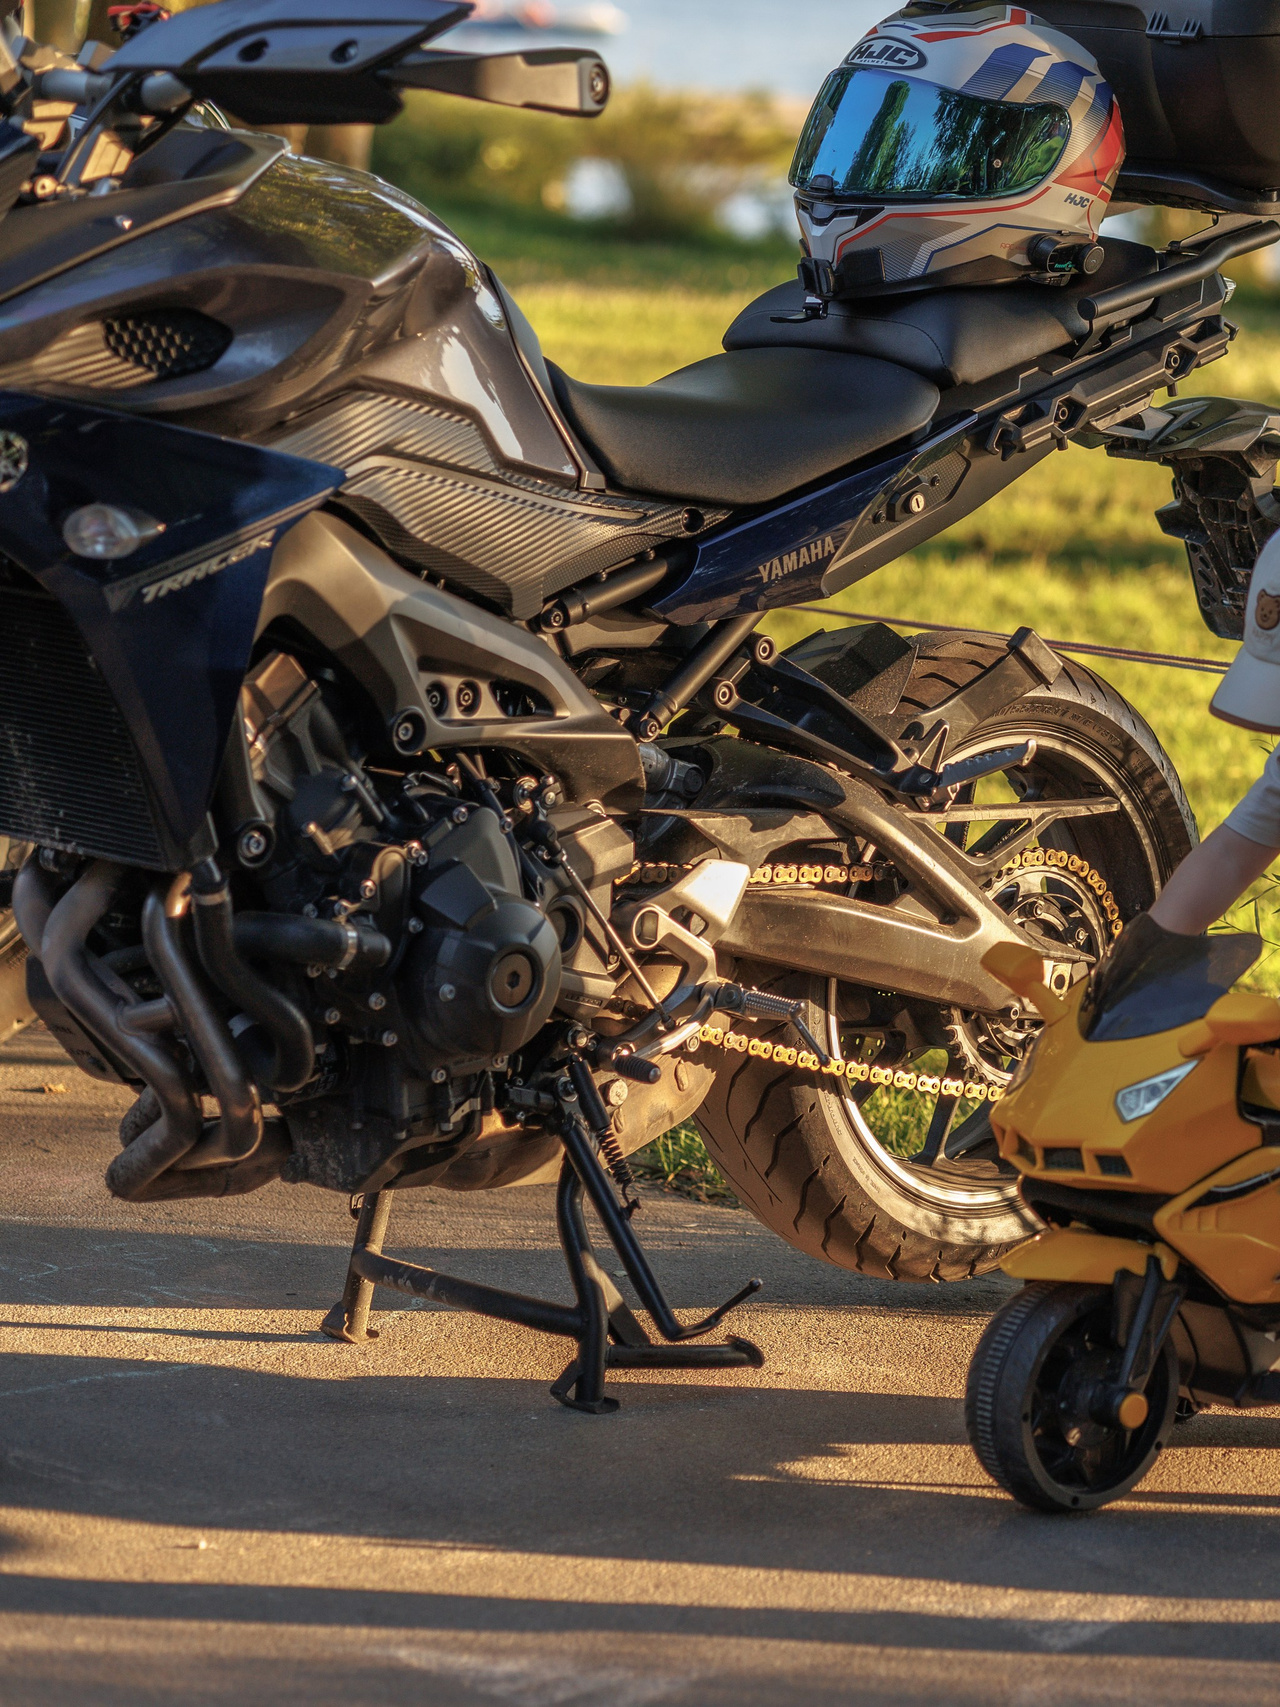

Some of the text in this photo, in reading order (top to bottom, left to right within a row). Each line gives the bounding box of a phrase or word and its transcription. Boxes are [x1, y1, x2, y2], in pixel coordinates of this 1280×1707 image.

[849, 44, 917, 65] HJC
[1064, 192, 1090, 208] HJC
[141, 528, 277, 604] TRACER
[758, 535, 836, 584] YAMAHA
